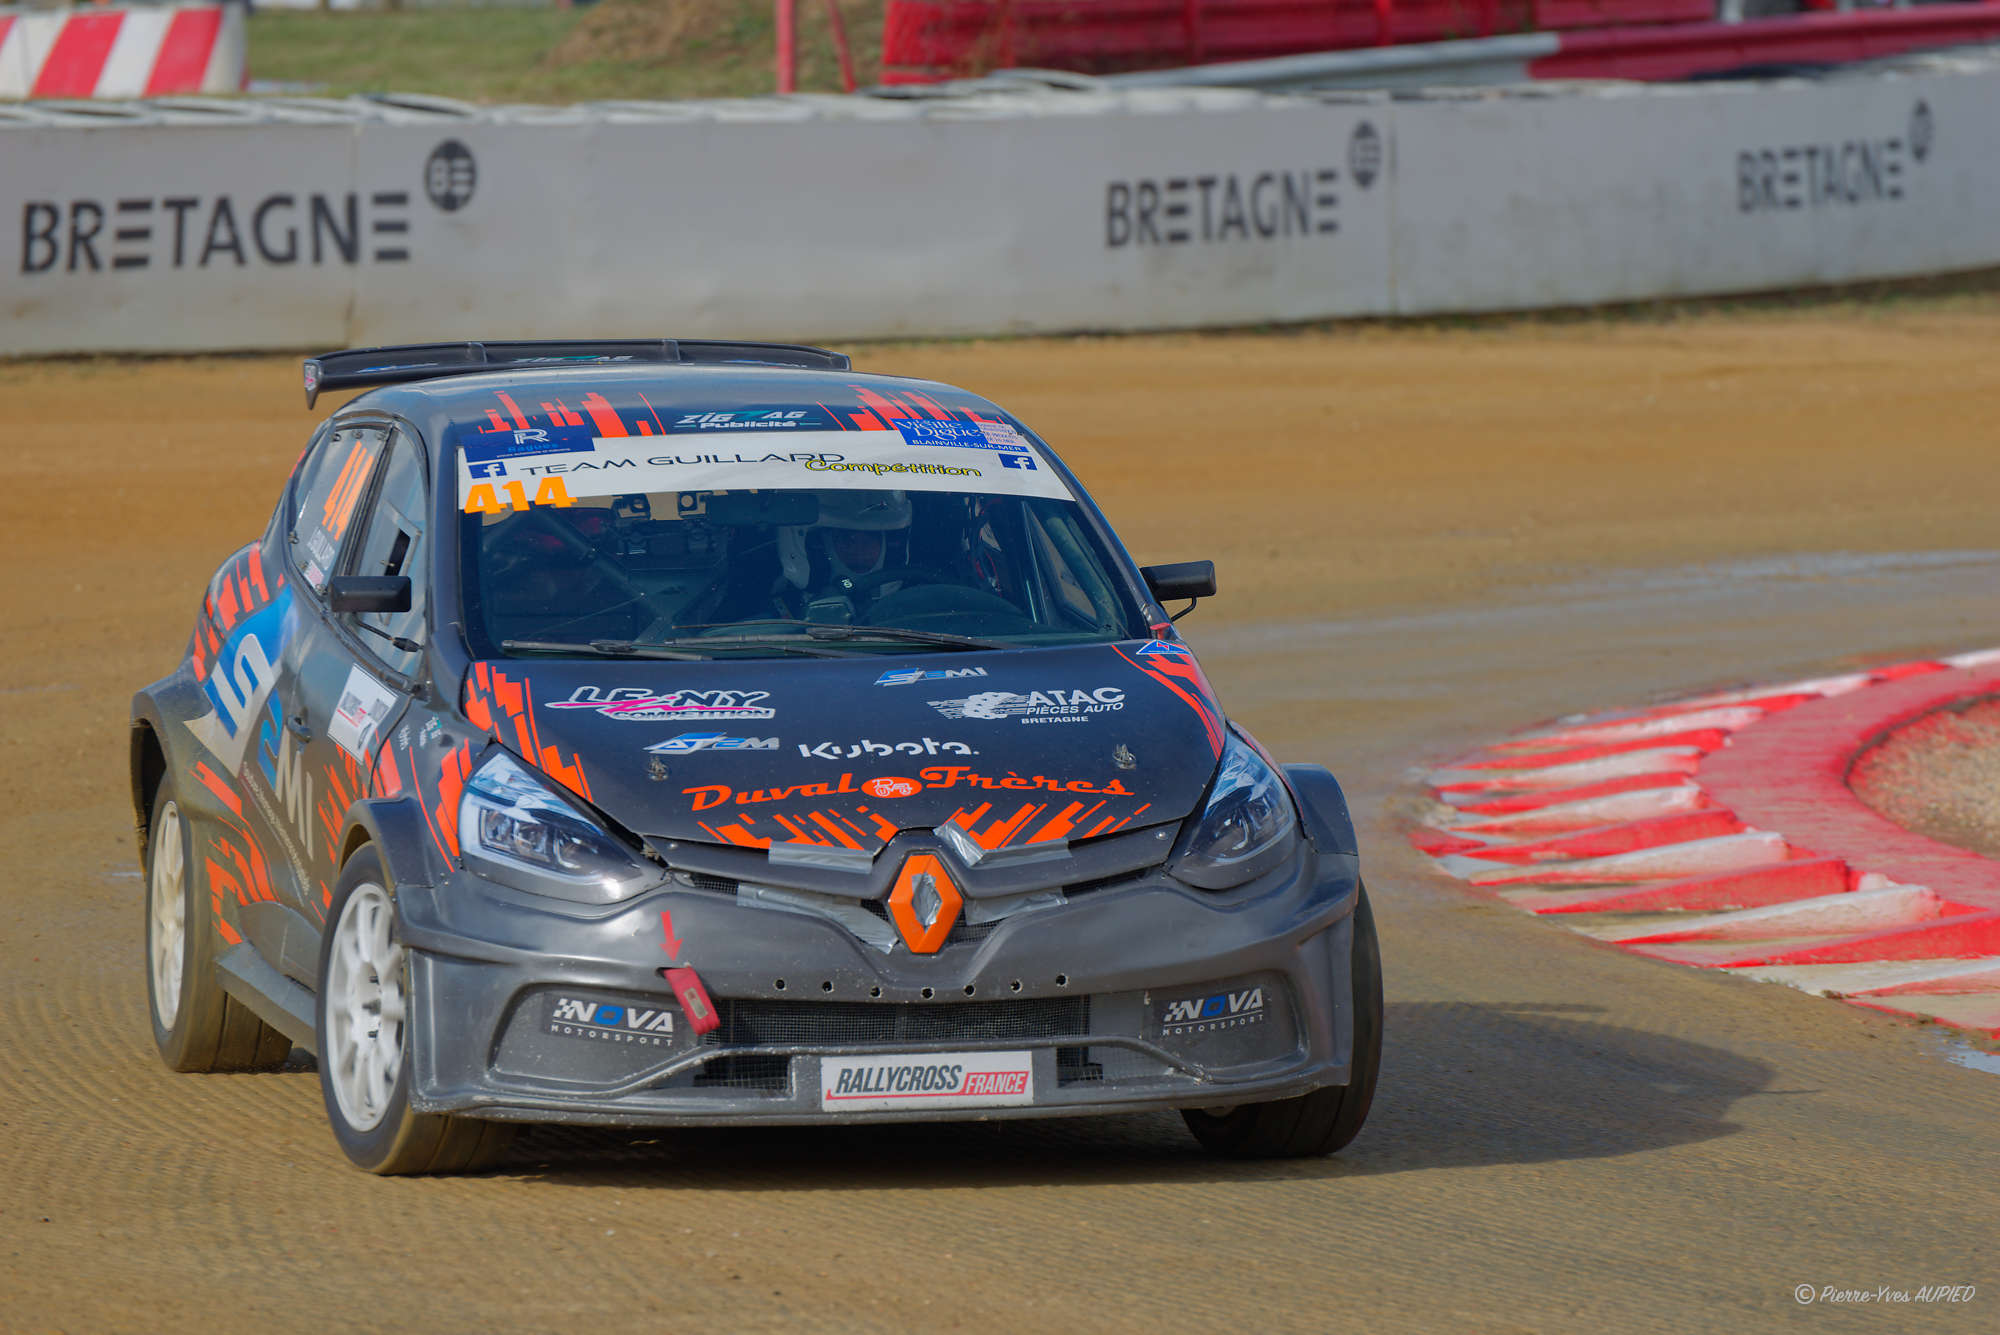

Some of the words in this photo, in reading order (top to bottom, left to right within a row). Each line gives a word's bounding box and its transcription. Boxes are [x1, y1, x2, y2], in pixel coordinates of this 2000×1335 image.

[1737, 139, 1903, 214] BRETAGNE
[1105, 168, 1340, 249] BRETAGNE
[19, 190, 412, 275] BRETAGNE
[700, 420, 797, 429] Publicité
[912, 427, 983, 441] Digue
[911, 438, 1023, 451] BLAINVILLE-SUR-MER
[519, 459, 637, 477] TEAM
[647, 451, 846, 466] GUILLARD
[463, 475, 578, 514] 414
[1026, 687, 1127, 706] ATAC
[1026, 704, 1080, 715] PIÈCES
[1083, 701, 1125, 713] AUTO
[612, 709, 773, 719] COMPETITION
[1020, 715, 1090, 724] BRETAGNE
[681, 772, 861, 812] Duval
[919, 765, 1136, 797] Frères
[562, 999, 674, 1033] NOVA
[1173, 987, 1264, 1021] NOVA
[550, 1024, 673, 1047] MOTORSPORT
[1162, 1013, 1264, 1036] MOTORSPORT
[835, 1064, 962, 1094] RALLYCROSS
[965, 1072, 1027, 1093] FRANCE
